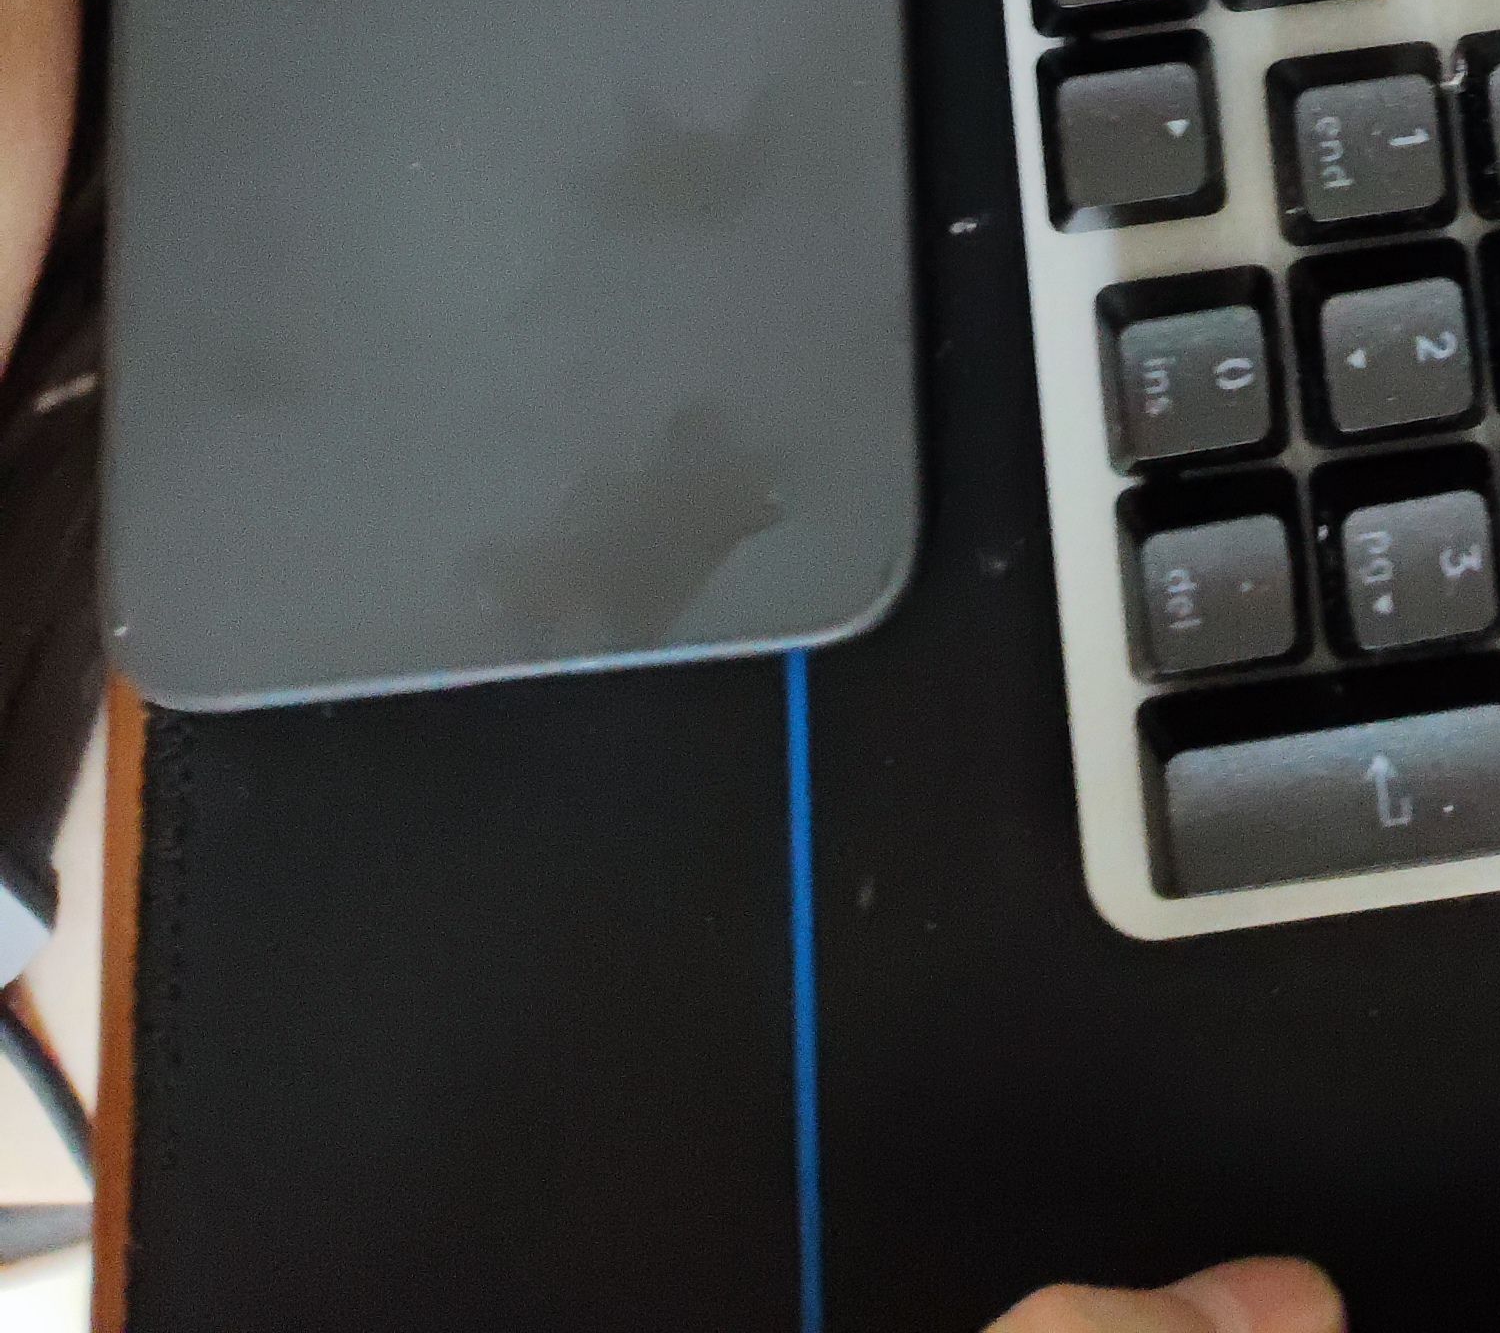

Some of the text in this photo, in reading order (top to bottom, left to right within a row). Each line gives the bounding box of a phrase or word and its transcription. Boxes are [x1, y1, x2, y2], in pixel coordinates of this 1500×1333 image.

[1314, 114, 1353, 189] end
[1389, 127, 1430, 147] 1
[1414, 331, 1459, 362] 2
[1213, 356, 1255, 391] 0
[1438, 542, 1483, 579] 3
[1166, 569, 1202, 630] del
